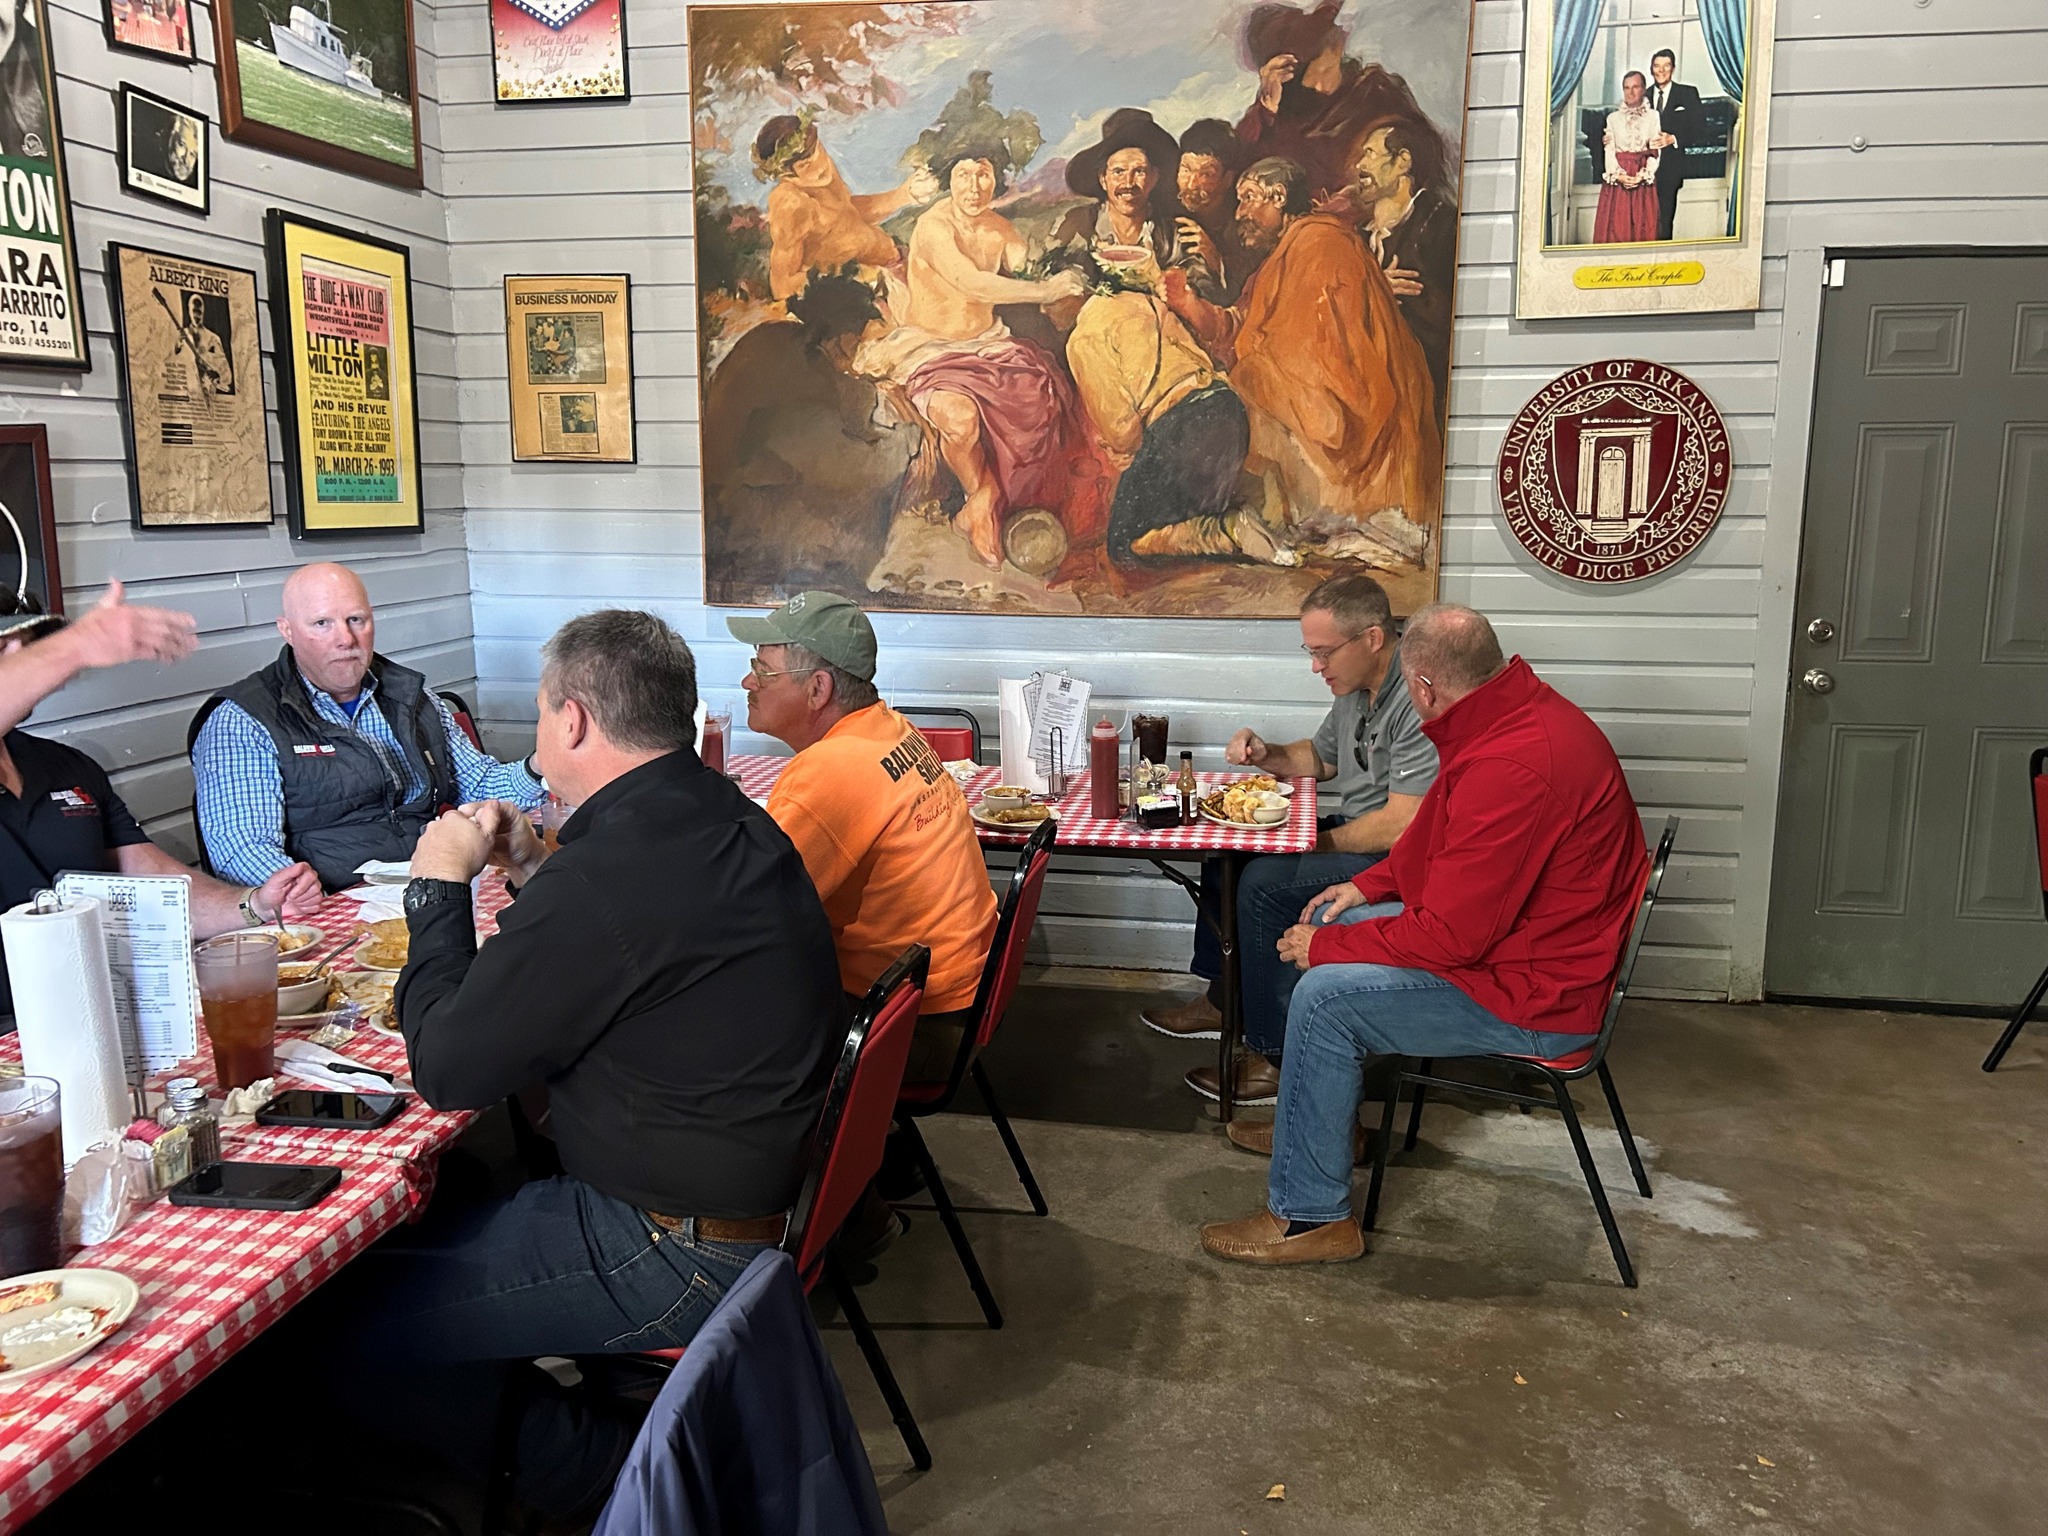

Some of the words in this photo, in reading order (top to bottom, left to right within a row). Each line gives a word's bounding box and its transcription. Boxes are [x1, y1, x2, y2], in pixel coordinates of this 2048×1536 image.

[0, 165, 60, 237] TON
[0, 247, 63, 291] RA
[1591, 268, 1615, 284] The
[1615, 267, 1645, 283] First
[1646, 266, 1687, 285] Couple
[149, 266, 195, 289] ALBERT
[197, 275, 229, 295] KING
[1, 286, 66, 320] ARRRITO
[302, 274, 317, 302] THE
[319, 278, 365, 312] HIDE-A-WAY
[367, 289, 385, 316] CLUB
[515, 294, 569, 305] BUSINESS
[570, 293, 618, 305] MONDAY
[0, 319, 24, 335] ro,
[30, 319, 49, 336] 14
[309, 312, 352, 328] WRIGHTSVILLE,
[353, 320, 380, 332] ARKANSAS
[369, 315, 384, 324] ROAD
[335, 327, 358, 337] PRESENTS
[9, 335, 26, 346] 085
[35, 338, 72, 350] 4555201
[306, 331, 360, 358] LITTLE
[308, 351, 364, 380] MILTON
[313, 399, 334, 411] AND
[338, 401, 354, 412] HIS
[357, 403, 387, 415] REVUE
[1504, 366, 1595, 459] UNIVERSITY
[1605, 362, 1634, 379] OF
[1641, 367, 1726, 454] ARKANSAS
[312, 413, 351, 429] FEATURING:
[353, 416, 366, 430] THE
[368, 418, 391, 431] ANGELS
[313, 428, 326, 439] TONY
[328, 429, 347, 440] BROWN
[347, 430, 353, 440] &
[354, 431, 364, 441] THE
[365, 431, 374, 441] ALL
[375, 432, 391, 443] STARS
[319, 441, 337, 451] ALONG
[354, 443, 364, 453] JOE
[332, 457, 362, 476] MARCH
[1503, 490, 1567, 572] VERITATE
[1575, 562, 1636, 581] DUCE
[1643, 487, 1724, 572] PROGREDI
[1595, 544, 1623, 555] 1871
[914, 800, 952, 831] Building
[111, 892, 134, 906] DOE'S
